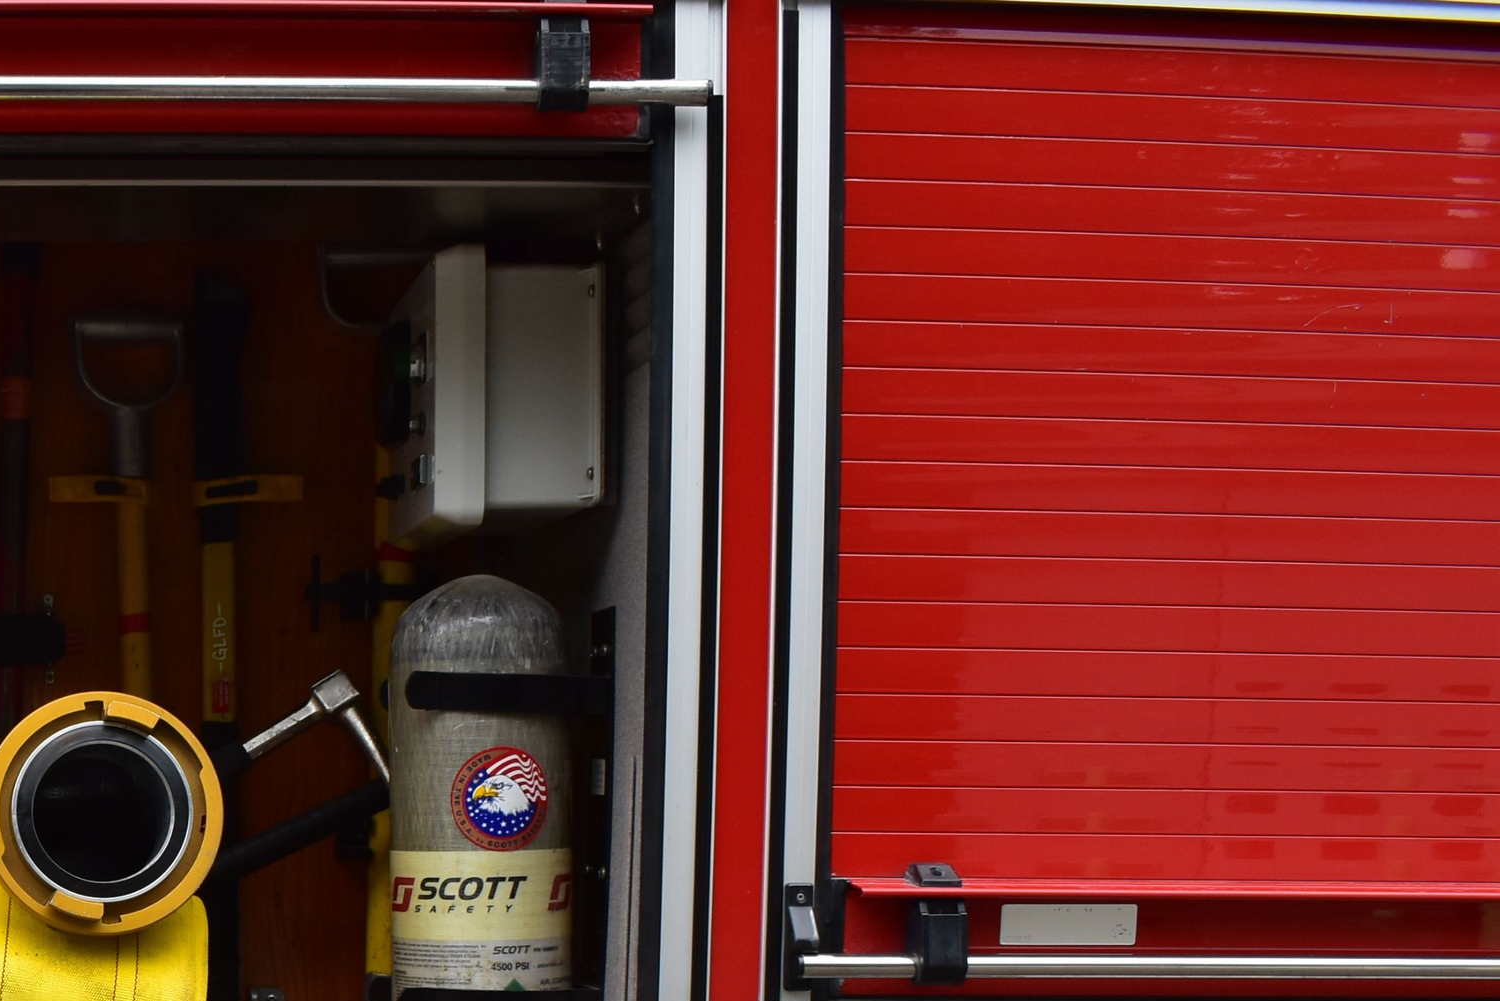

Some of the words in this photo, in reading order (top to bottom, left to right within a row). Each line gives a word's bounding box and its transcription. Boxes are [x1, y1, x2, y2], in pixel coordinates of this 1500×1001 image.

[467, 753, 491, 773] MADE
[454, 787, 462, 806] THE
[487, 840, 519, 848] SCOTT
[417, 876, 528, 901] SCOTT
[414, 905, 514, 914] SAFETY
[492, 945, 531, 955] SCOTT
[491, 963, 513, 971] 4500
[515, 962, 530, 970] PSI
